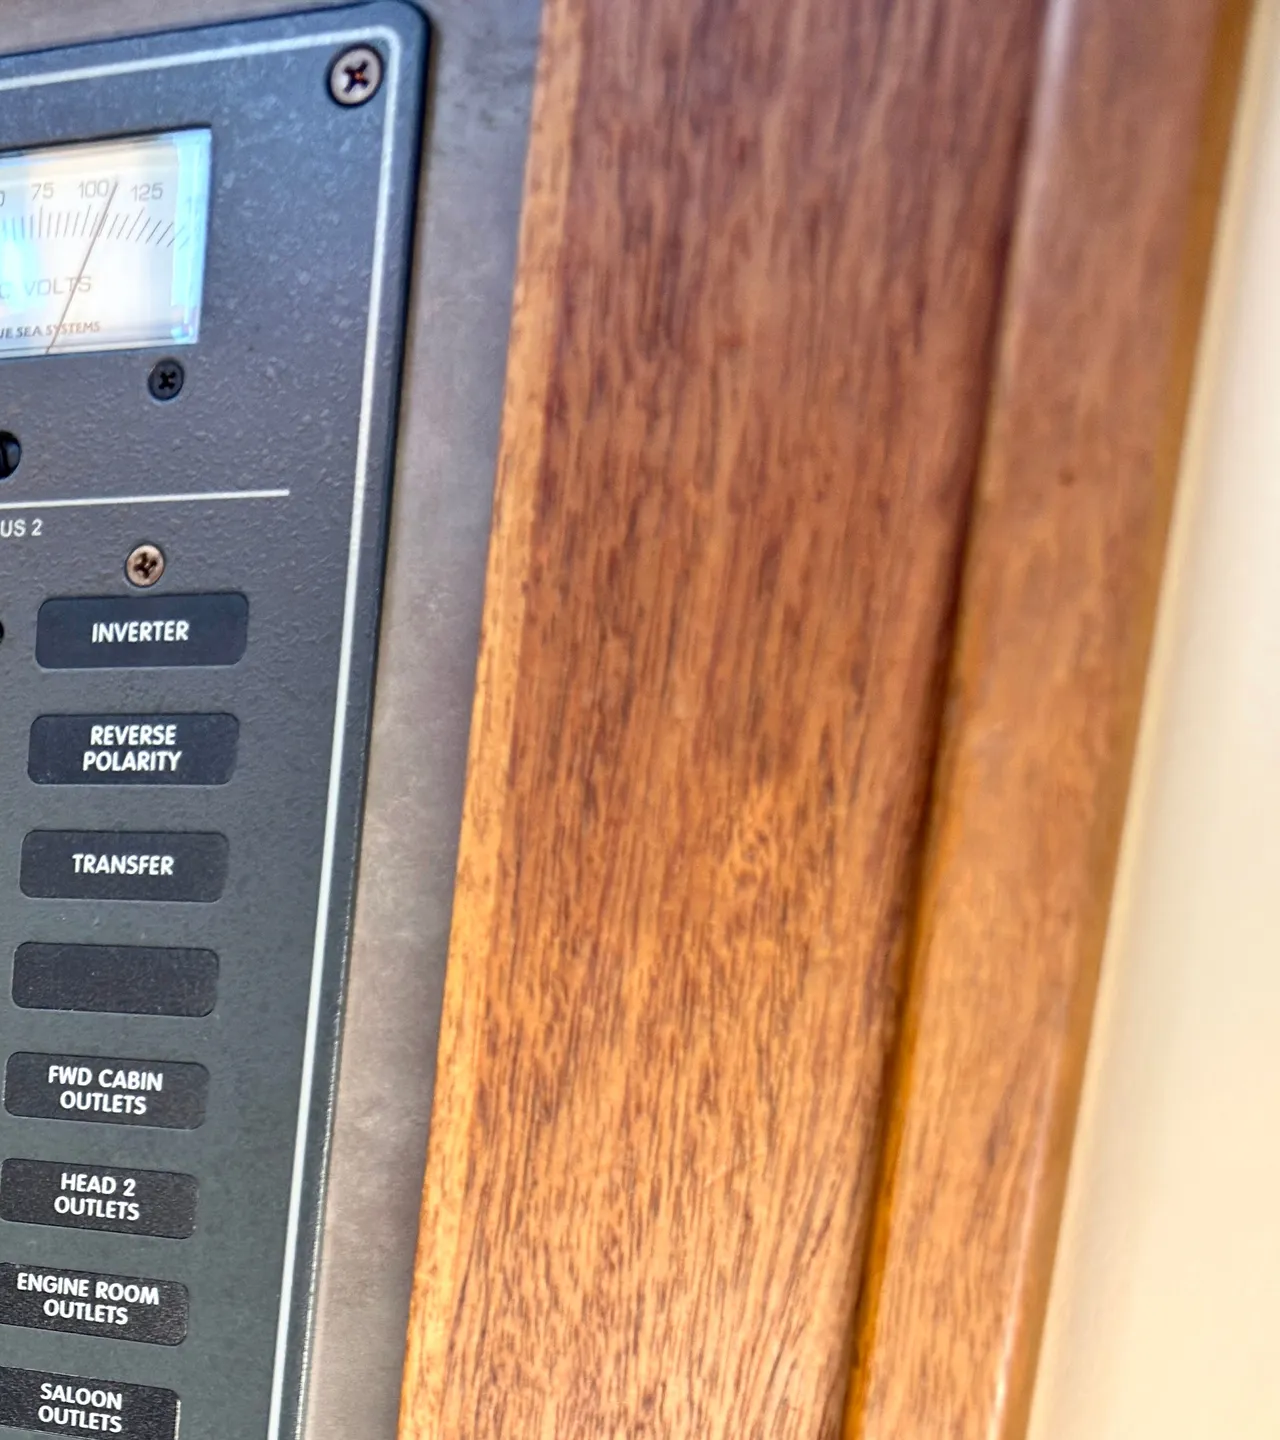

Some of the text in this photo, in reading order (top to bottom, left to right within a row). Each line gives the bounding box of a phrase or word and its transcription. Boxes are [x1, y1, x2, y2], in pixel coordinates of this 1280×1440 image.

[31, 182, 54, 201] 75
[78, 179, 109, 199] 100
[130, 182, 164, 202] 125
[24, 275, 93, 297] VOLTS
[15, 325, 42, 339] SEA
[45, 321, 101, 338] SYSTEMS
[31, 517, 43, 537] 2
[91, 619, 190, 644] INVERTER
[89, 724, 177, 747] REVERSE
[82, 749, 183, 773] POLARITY
[71, 853, 175, 877] TRANSFER
[47, 1065, 164, 1092] FWD CABIN
[59, 1092, 148, 1116] OUTLETS
[59, 1172, 136, 1198] HEAD 2
[53, 1196, 141, 1222] OUTLETS
[16, 1273, 160, 1307] ENGINE ROOM
[42, 1299, 129, 1327] OUTLETS
[39, 1382, 123, 1411] SALOON
[37, 1406, 123, 1433] OUTLETS
